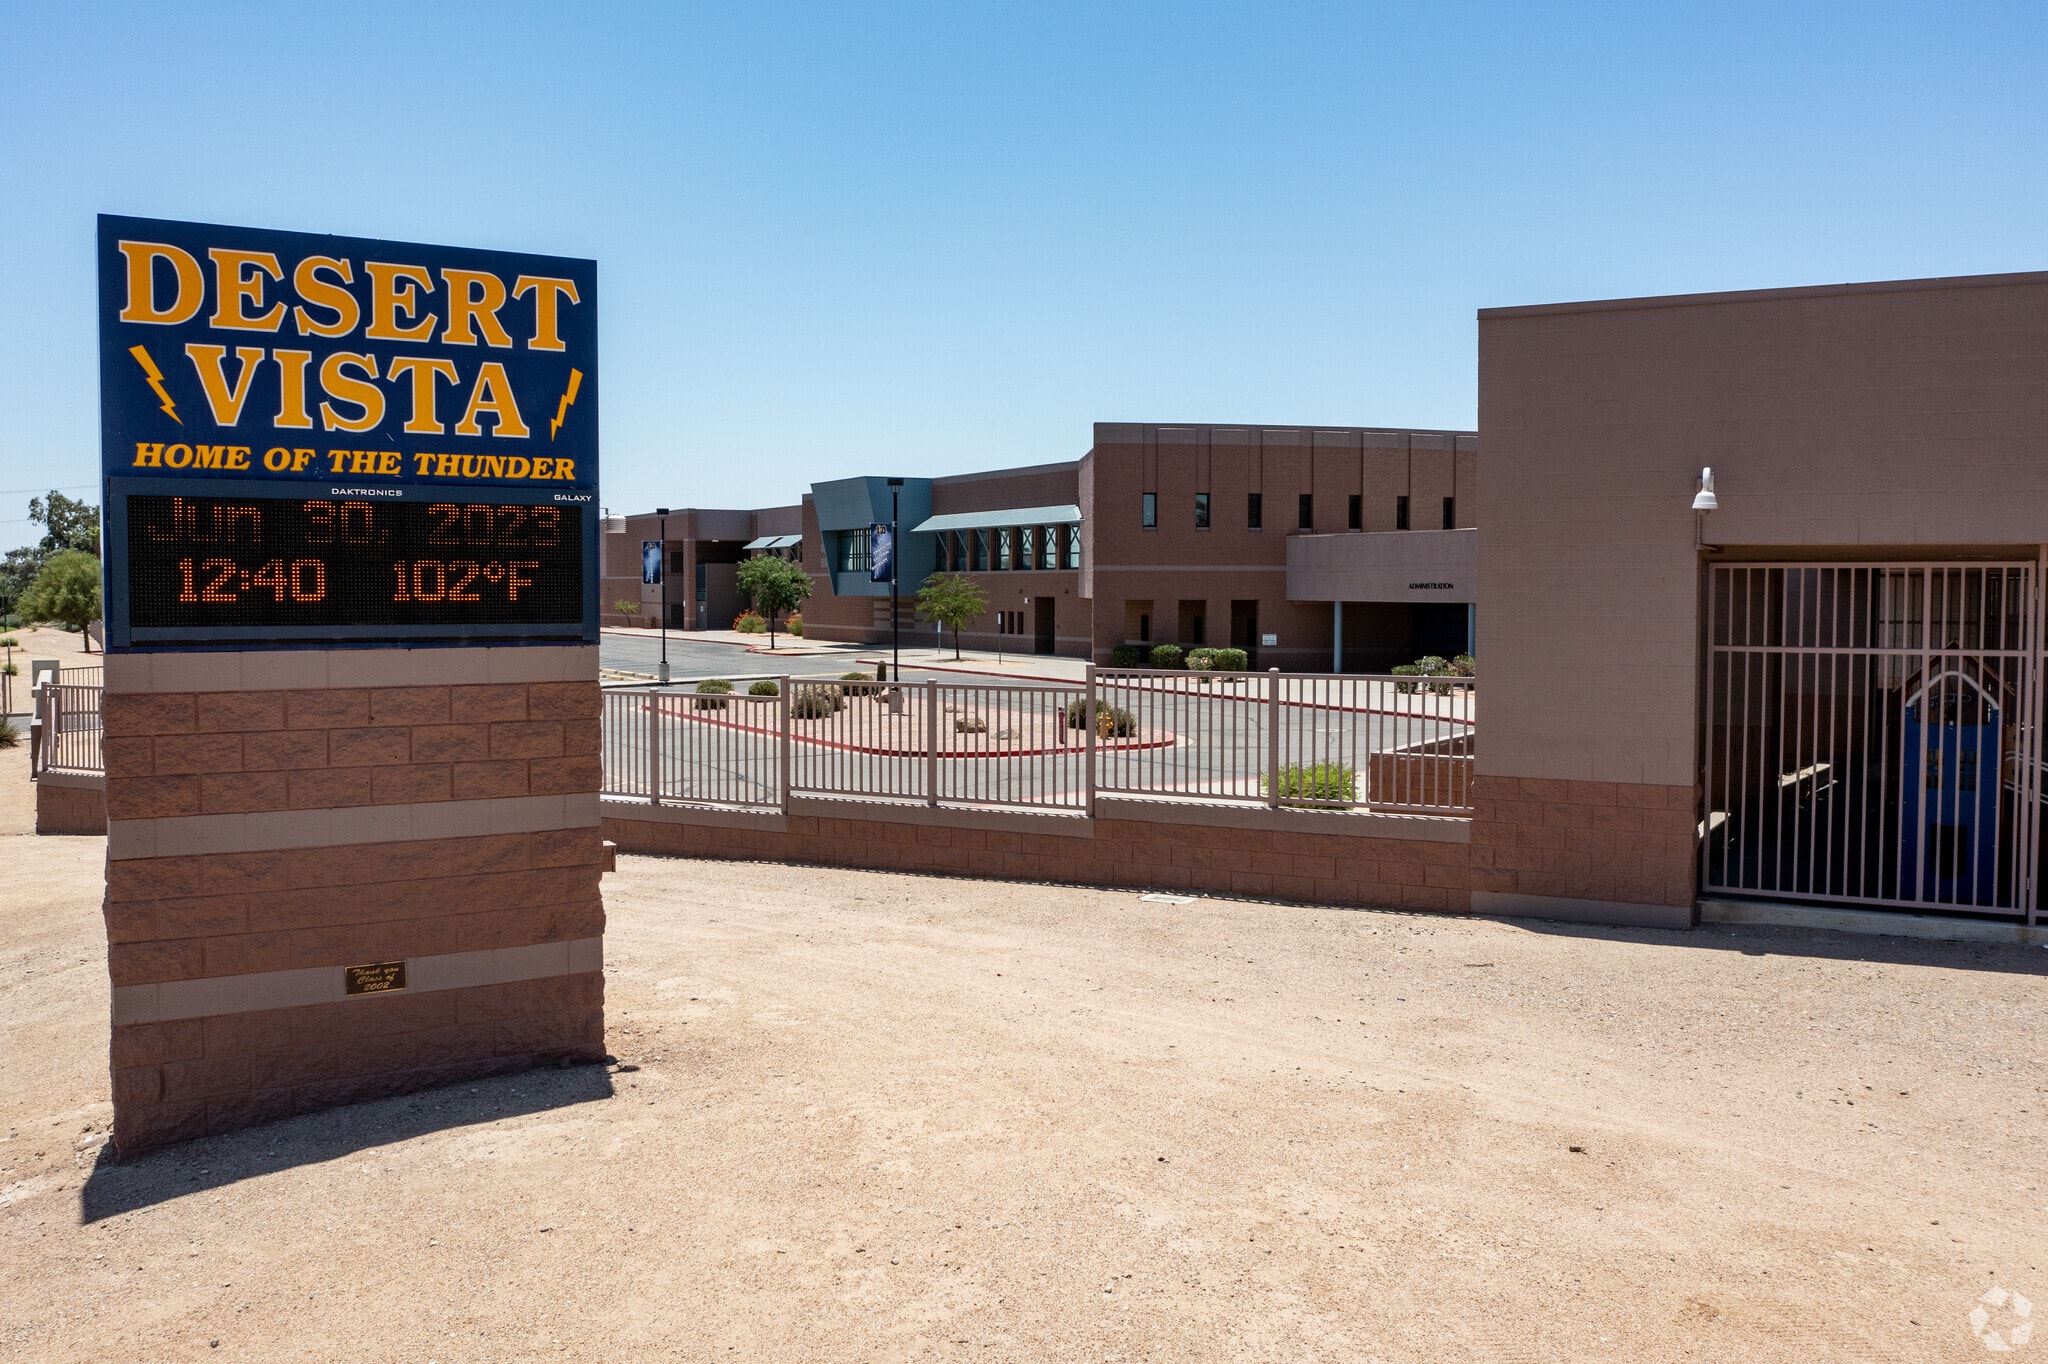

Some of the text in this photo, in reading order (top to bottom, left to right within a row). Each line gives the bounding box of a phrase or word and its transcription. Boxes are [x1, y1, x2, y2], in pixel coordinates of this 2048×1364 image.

[118, 239, 581, 353] DESERT
[185, 342, 531, 439] VISTA
[132, 442, 576, 481] HOME OF THE THUNDER
[331, 487, 403, 497] DAKTRONICS
[554, 494, 592, 502] GALAXY
[147, 497, 561, 546] Jun 30, 2023
[179, 558, 540, 602] 12:40 102°F
[1408, 582, 1454, 590] ADMINISTRATION
[357, 975, 383, 985] Class
